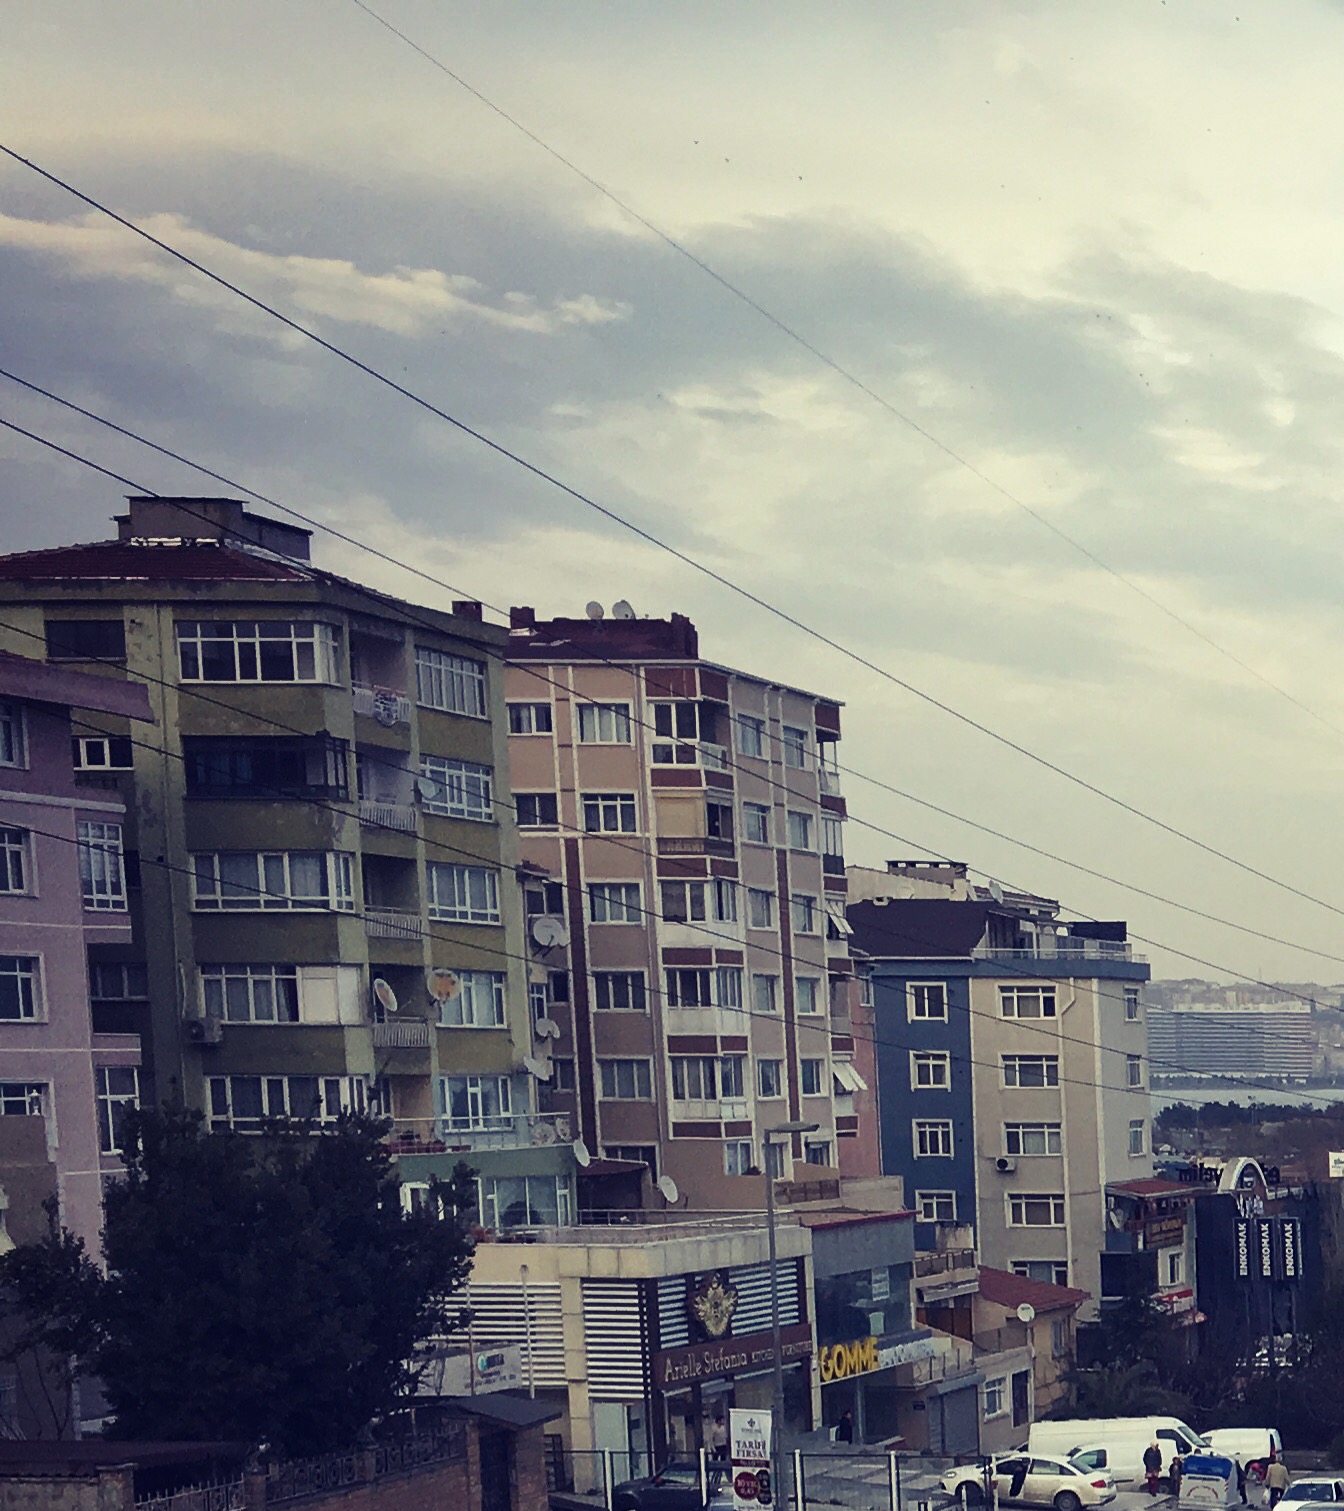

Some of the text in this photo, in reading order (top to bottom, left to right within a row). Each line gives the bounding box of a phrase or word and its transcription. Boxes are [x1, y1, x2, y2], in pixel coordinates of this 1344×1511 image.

[1238, 1223, 1248, 1276] ENKOMAK
[1260, 1223, 1271, 1276] ENKOMAK
[1283, 1223, 1295, 1276] ENKOMAK
[704, 1347, 747, 1373] Stefania
[819, 1336, 880, 1382] GOMME
